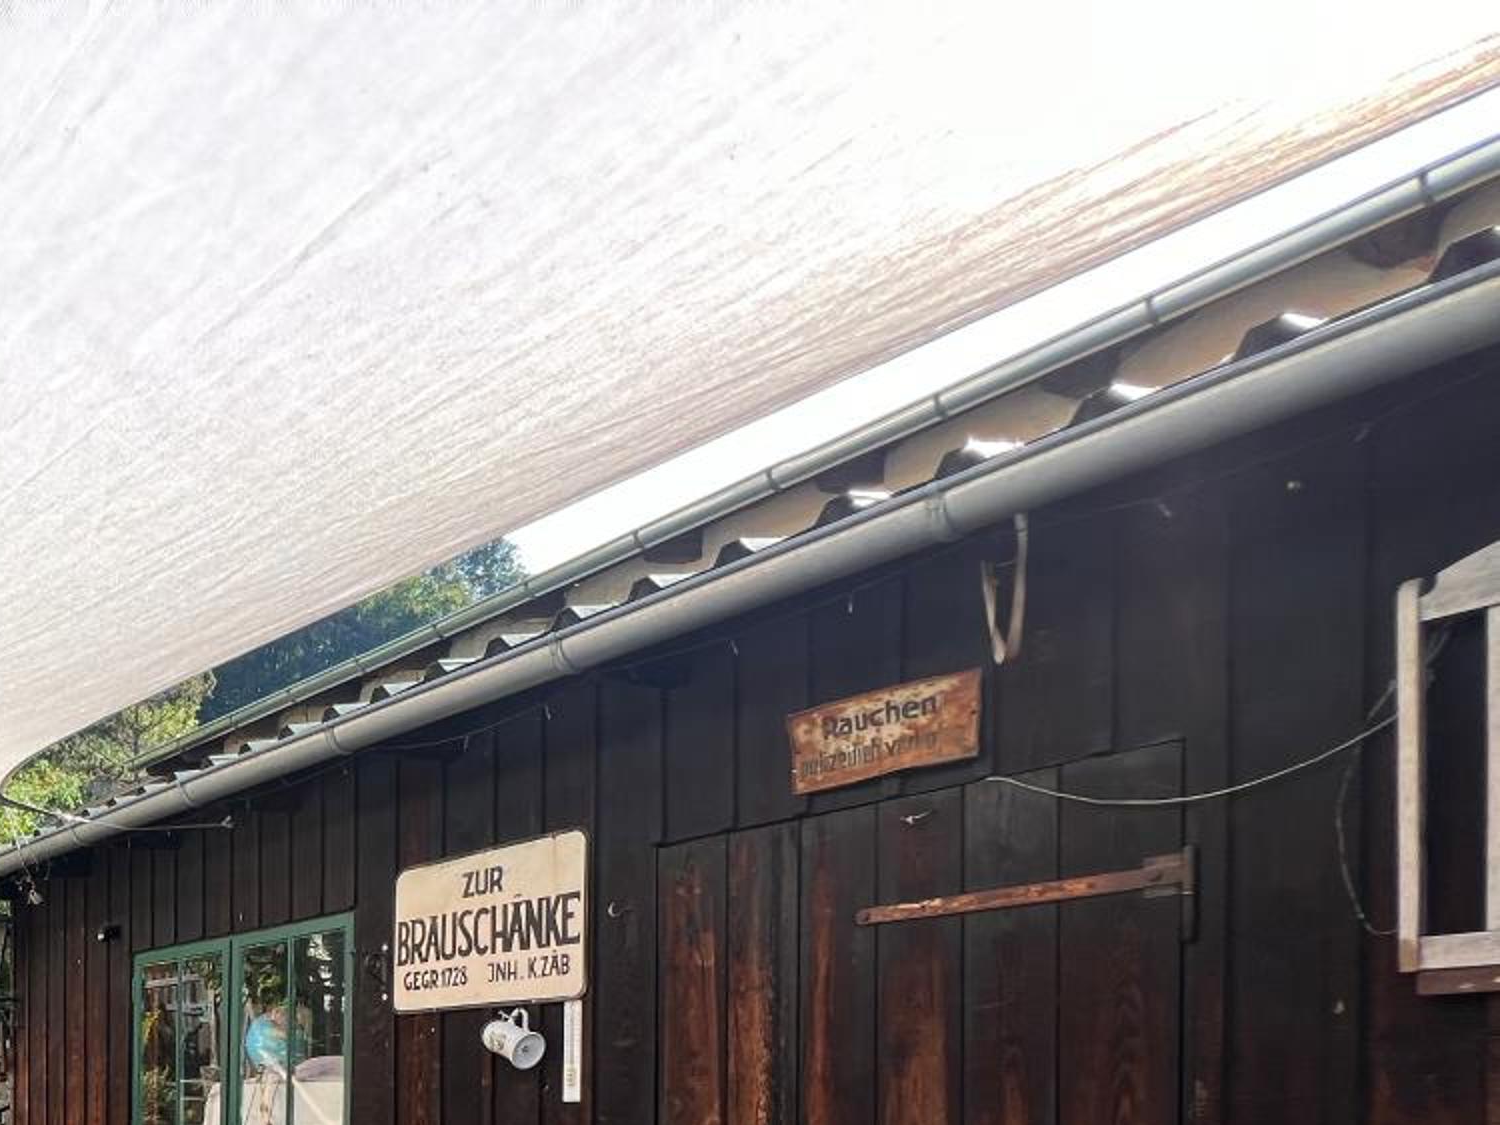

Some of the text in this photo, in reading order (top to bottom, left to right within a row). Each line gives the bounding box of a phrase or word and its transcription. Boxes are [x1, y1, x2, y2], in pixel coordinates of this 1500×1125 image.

[821, 696, 937, 739] Rauchen
[462, 866, 504, 898] ZUR
[397, 891, 581, 967] BRAUSCHÄNKE
